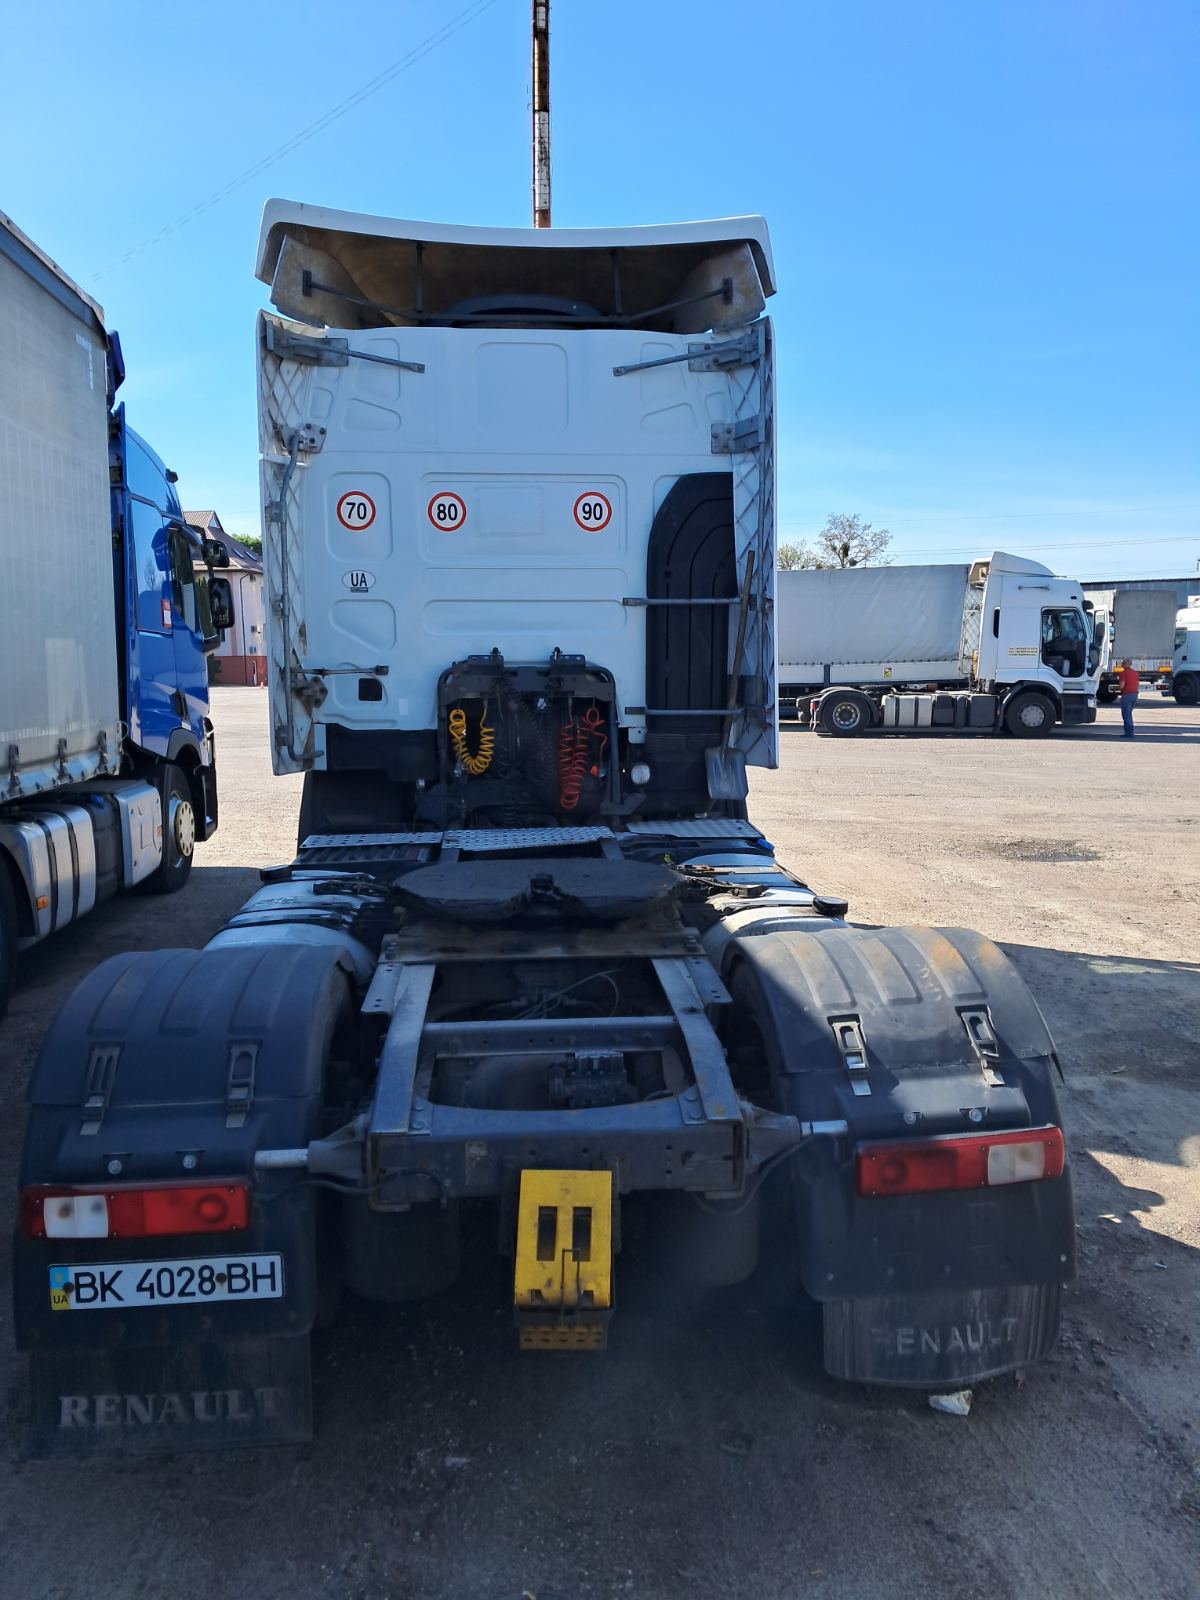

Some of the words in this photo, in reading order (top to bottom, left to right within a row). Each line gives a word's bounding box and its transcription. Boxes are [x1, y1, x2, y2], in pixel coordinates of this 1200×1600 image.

[345, 502, 368, 519] 70
[437, 503, 458, 521] 80
[581, 502, 604, 520] 90
[350, 572, 368, 587] UA
[74, 1271, 124, 1303] BK
[136, 1264, 216, 1299] 4028
[226, 1261, 277, 1293] BH
[53, 1295, 69, 1304] UA
[59, 1388, 283, 1428] RENAULT
